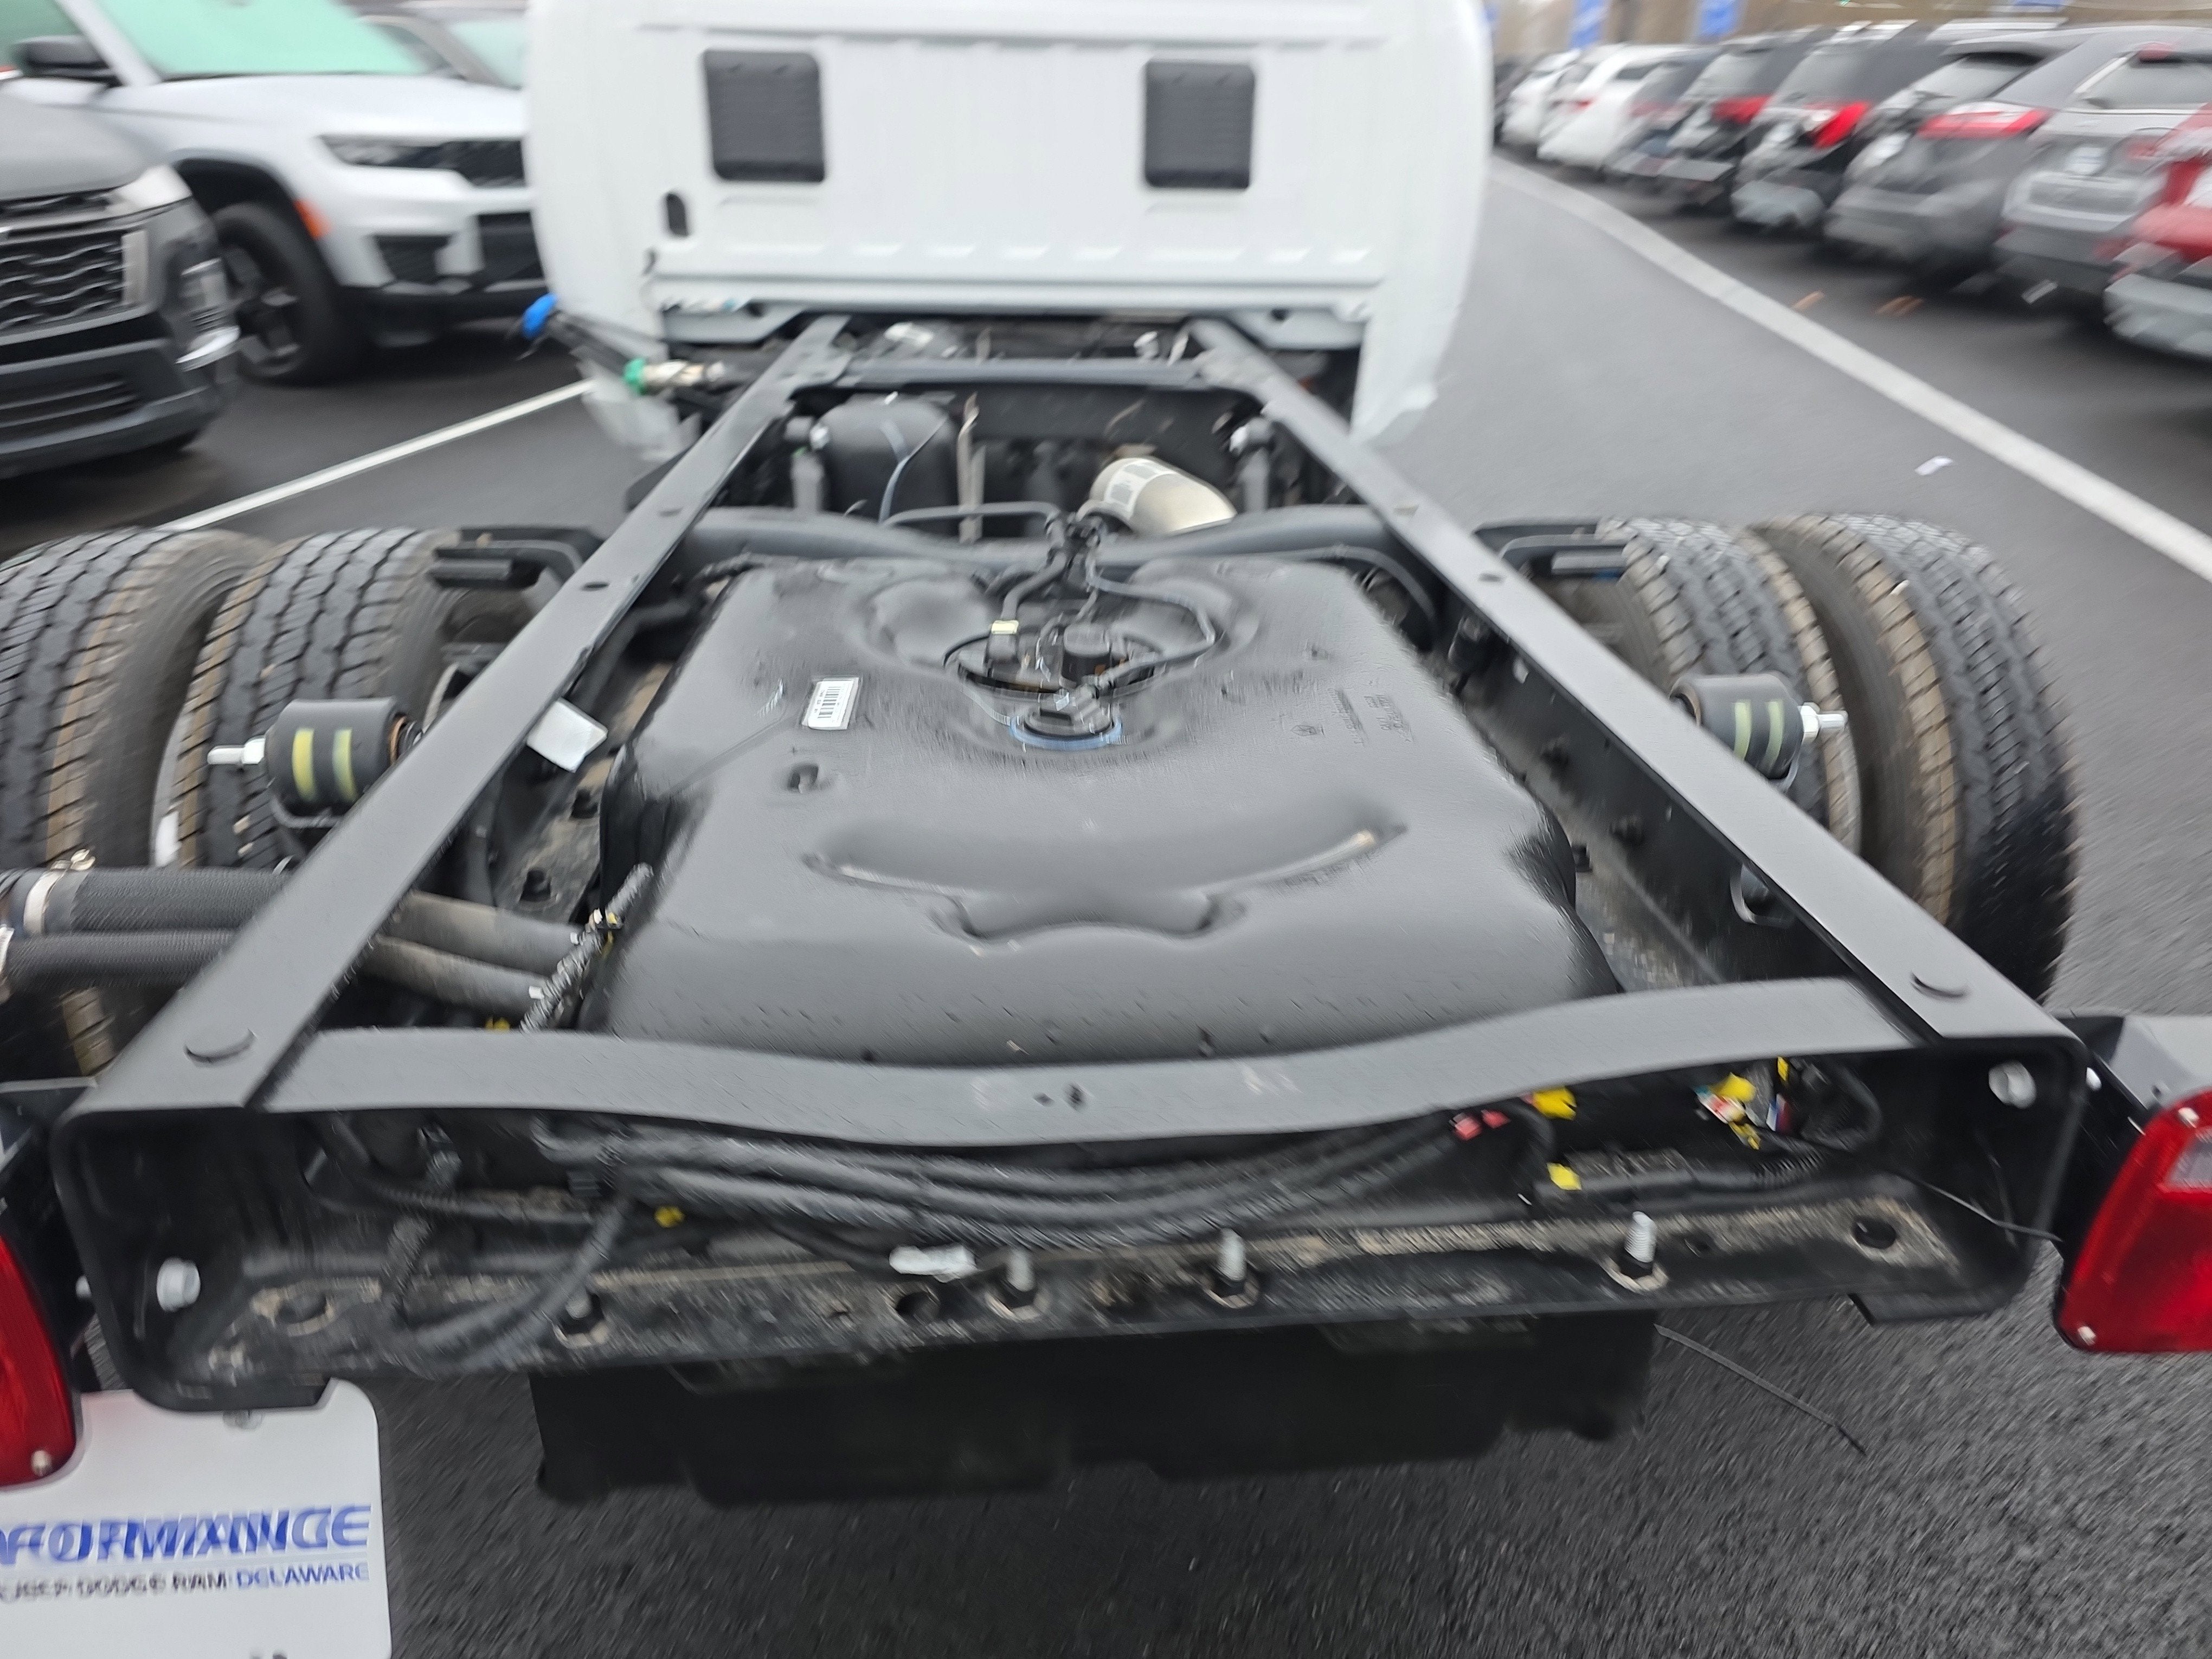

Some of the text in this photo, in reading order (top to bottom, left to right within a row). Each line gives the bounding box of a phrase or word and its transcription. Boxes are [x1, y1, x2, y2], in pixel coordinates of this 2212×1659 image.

[0, 1504, 371, 1565] FORMANCE
[76, 1572, 166, 1597] DODGE
[172, 1570, 228, 1591] RAM
[236, 1561, 370, 1589] DELAWARE
